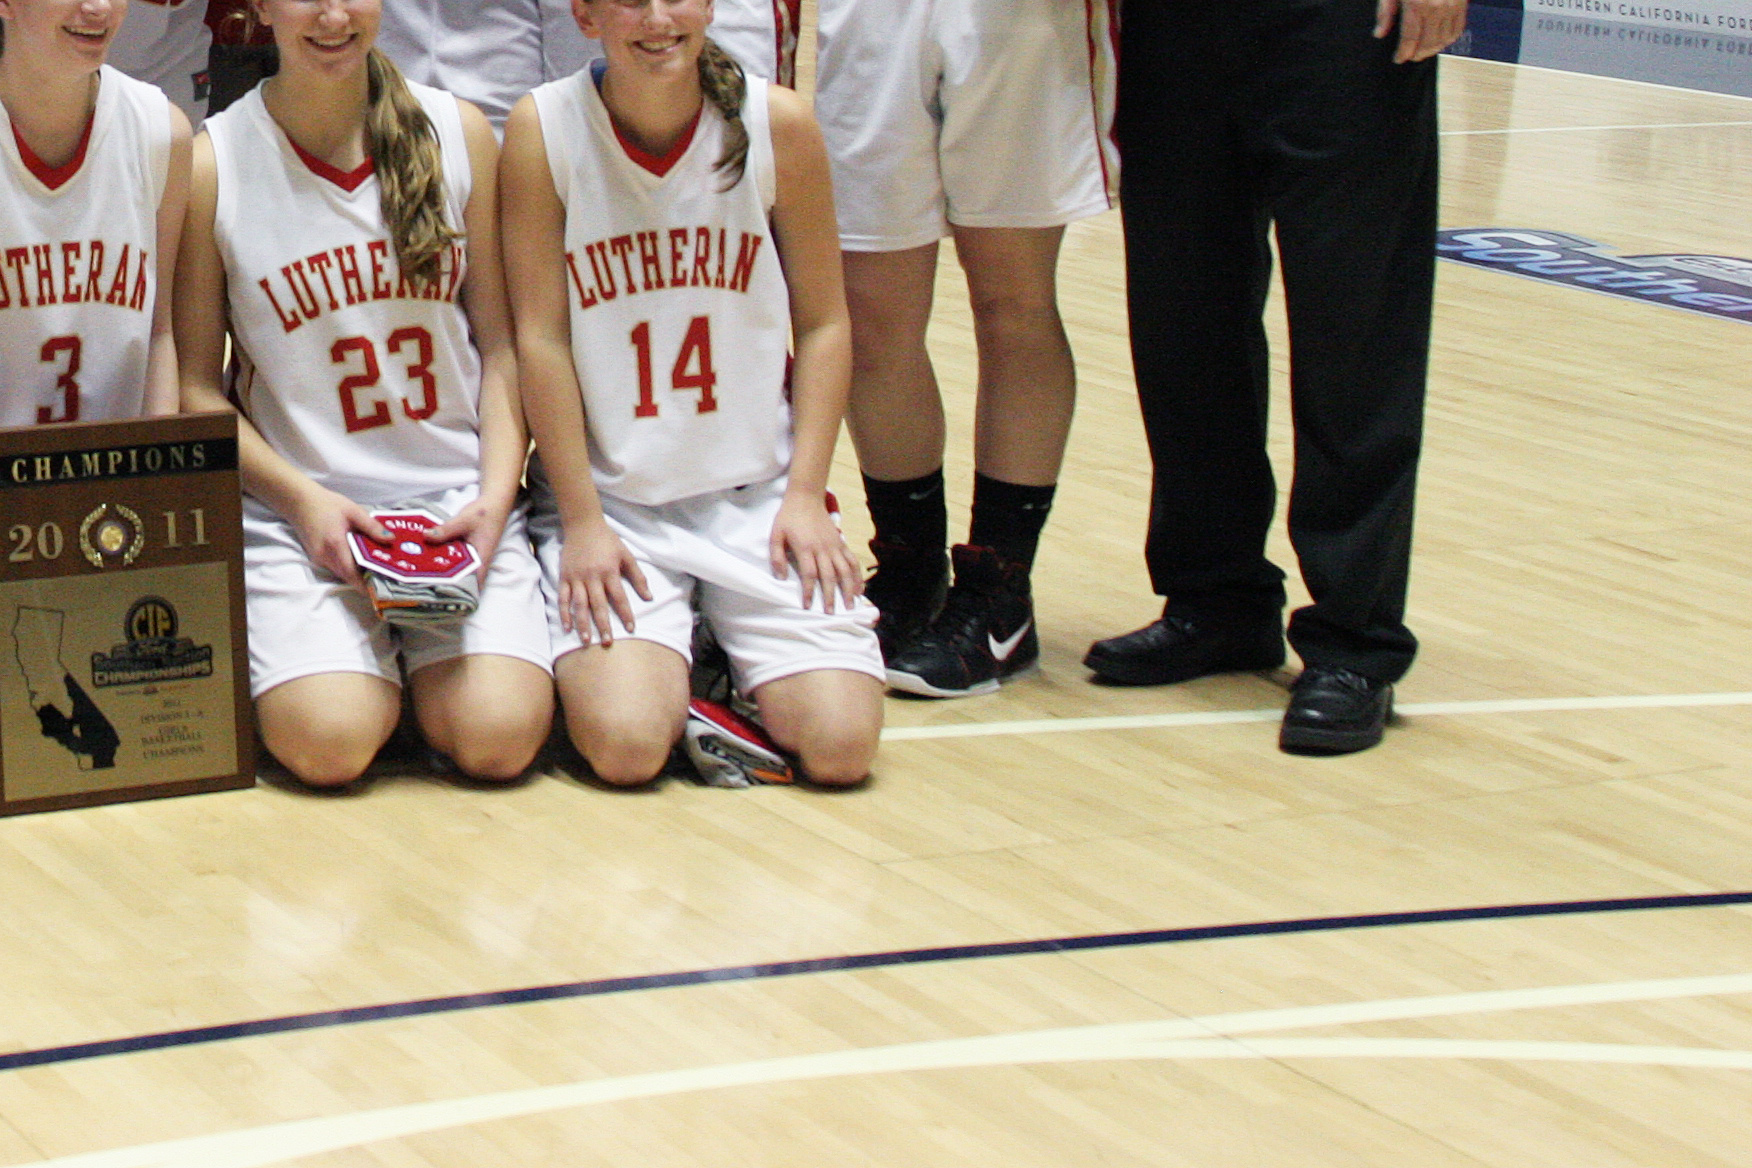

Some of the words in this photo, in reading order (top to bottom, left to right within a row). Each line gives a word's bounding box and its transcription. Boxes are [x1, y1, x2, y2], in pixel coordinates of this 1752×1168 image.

[1619, 4, 1710, 26] CALIFORNIA
[565, 226, 764, 311] LUTHERAN
[36, 335, 84, 424] 3
[330, 326, 439, 434] 23
[628, 315, 718, 419] 14
[11, 444, 206, 483] CHAMPIONS
[8, 521, 64, 563] 20
[163, 508, 210, 548] 11
